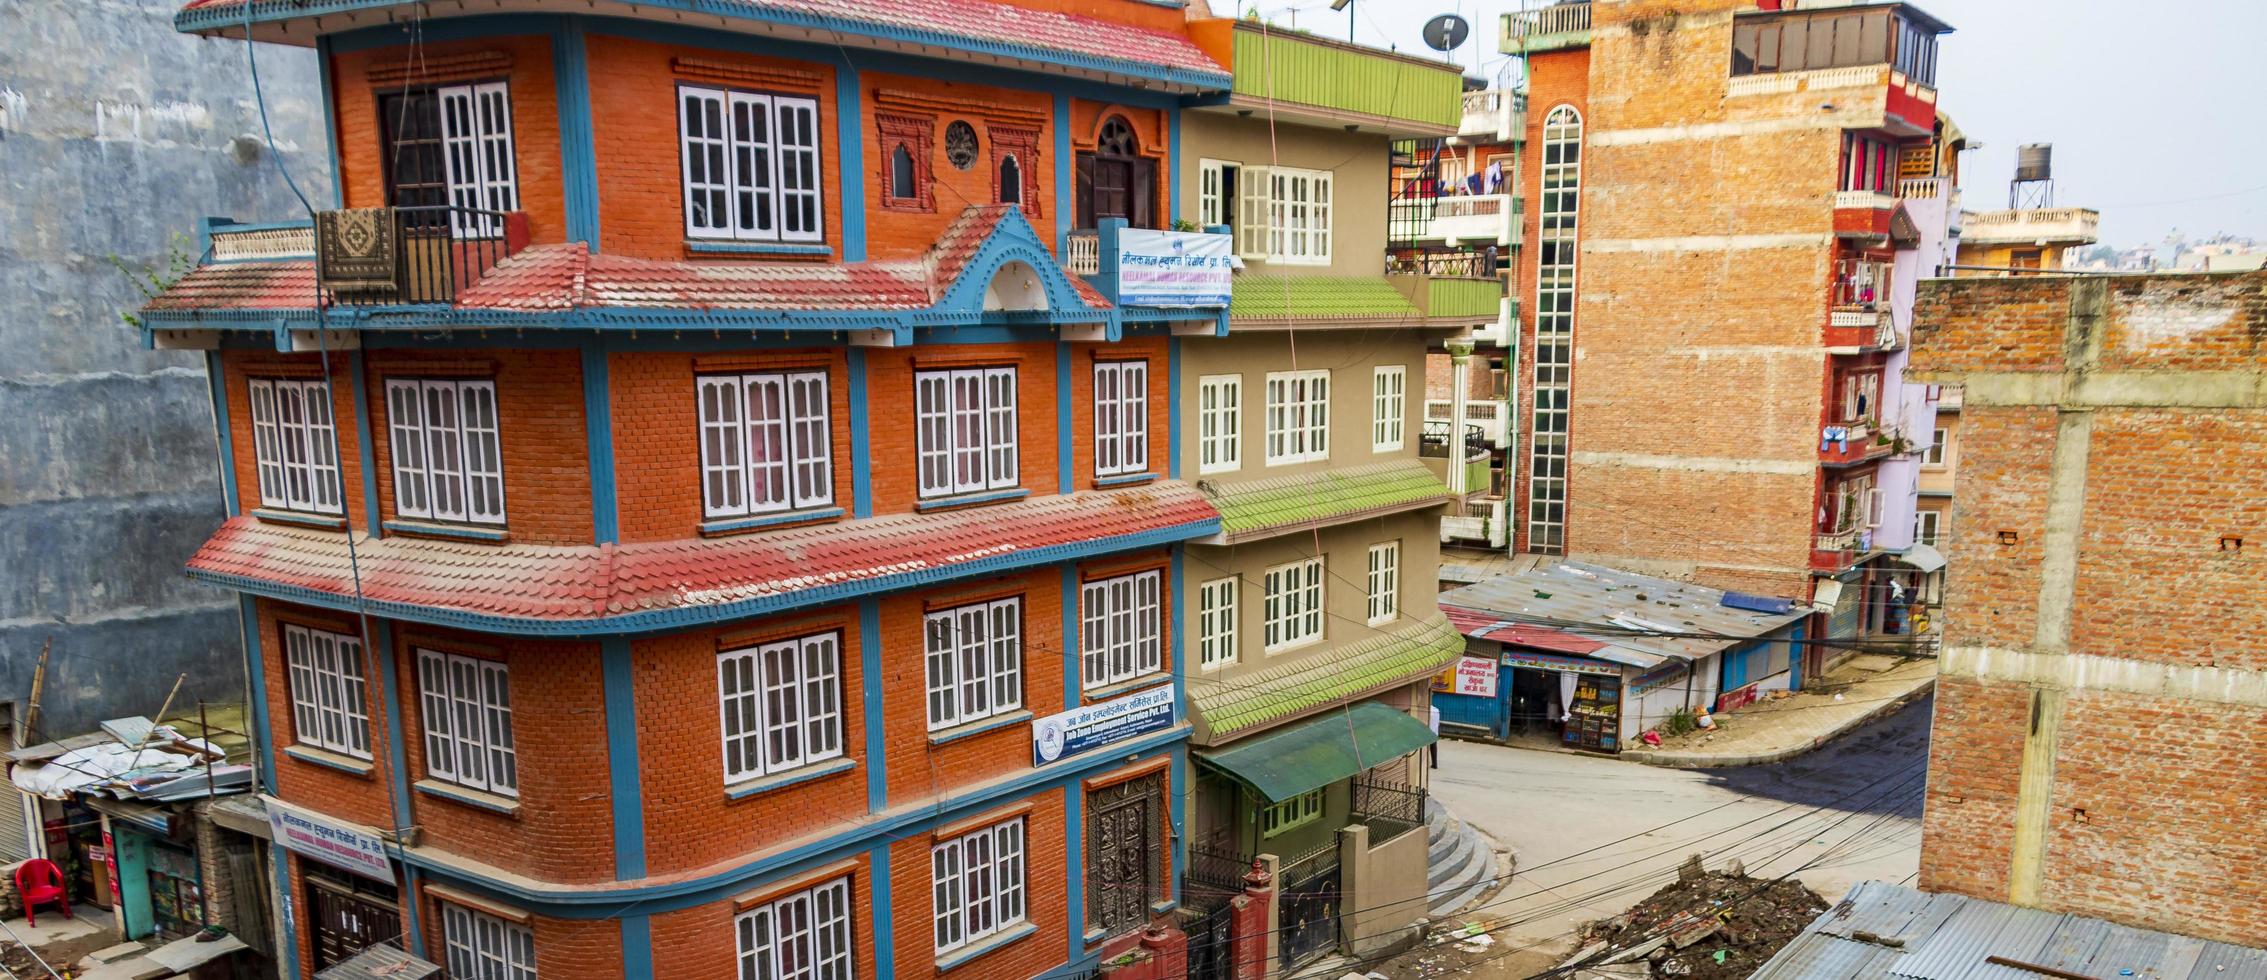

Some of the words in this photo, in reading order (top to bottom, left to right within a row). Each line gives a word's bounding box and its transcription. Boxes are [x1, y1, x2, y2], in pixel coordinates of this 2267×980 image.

[1066, 730, 1076, 740] Job
[1077, 726, 1091, 738] Zone
[1091, 716, 1127, 734] Employment
[1127, 709, 1149, 724] Service
